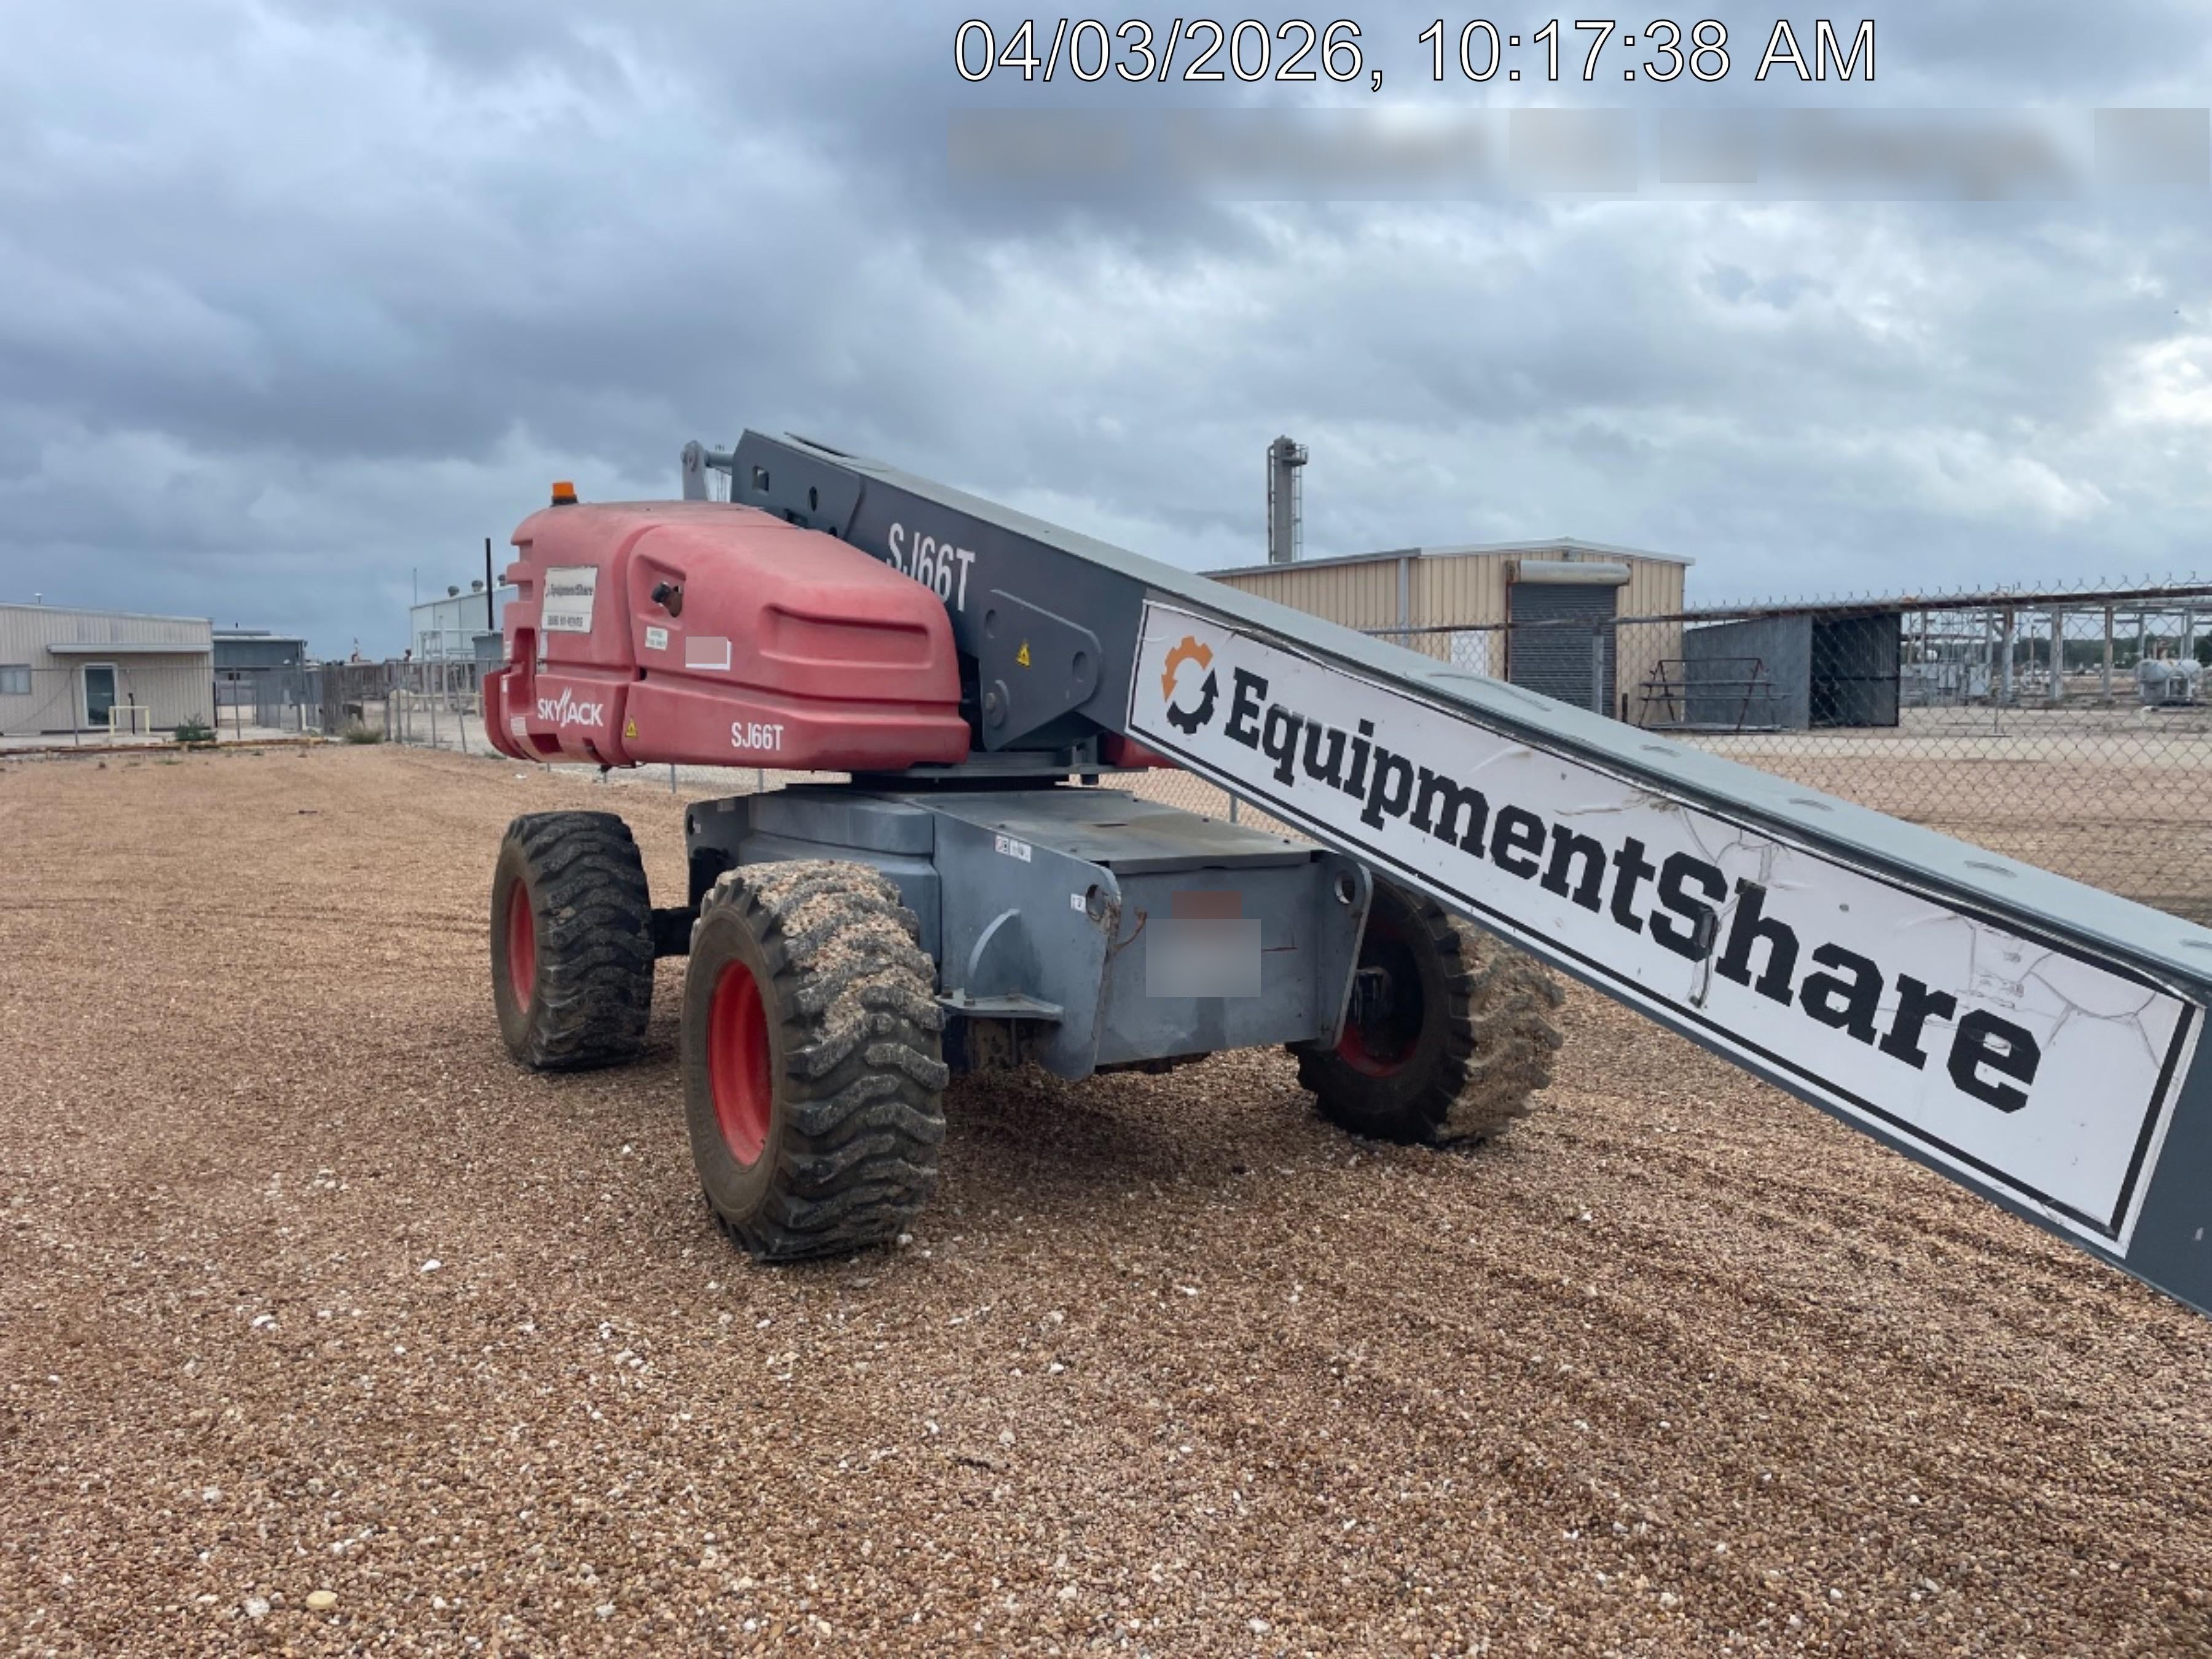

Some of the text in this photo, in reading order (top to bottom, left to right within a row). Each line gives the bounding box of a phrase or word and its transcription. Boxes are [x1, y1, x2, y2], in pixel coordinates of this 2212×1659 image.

[887, 522, 976, 612] SJ66T
[538, 686, 603, 728] SKYJACK
[731, 722, 784, 751] SJ66T
[1224, 667, 2042, 1114] EquipmentShare
